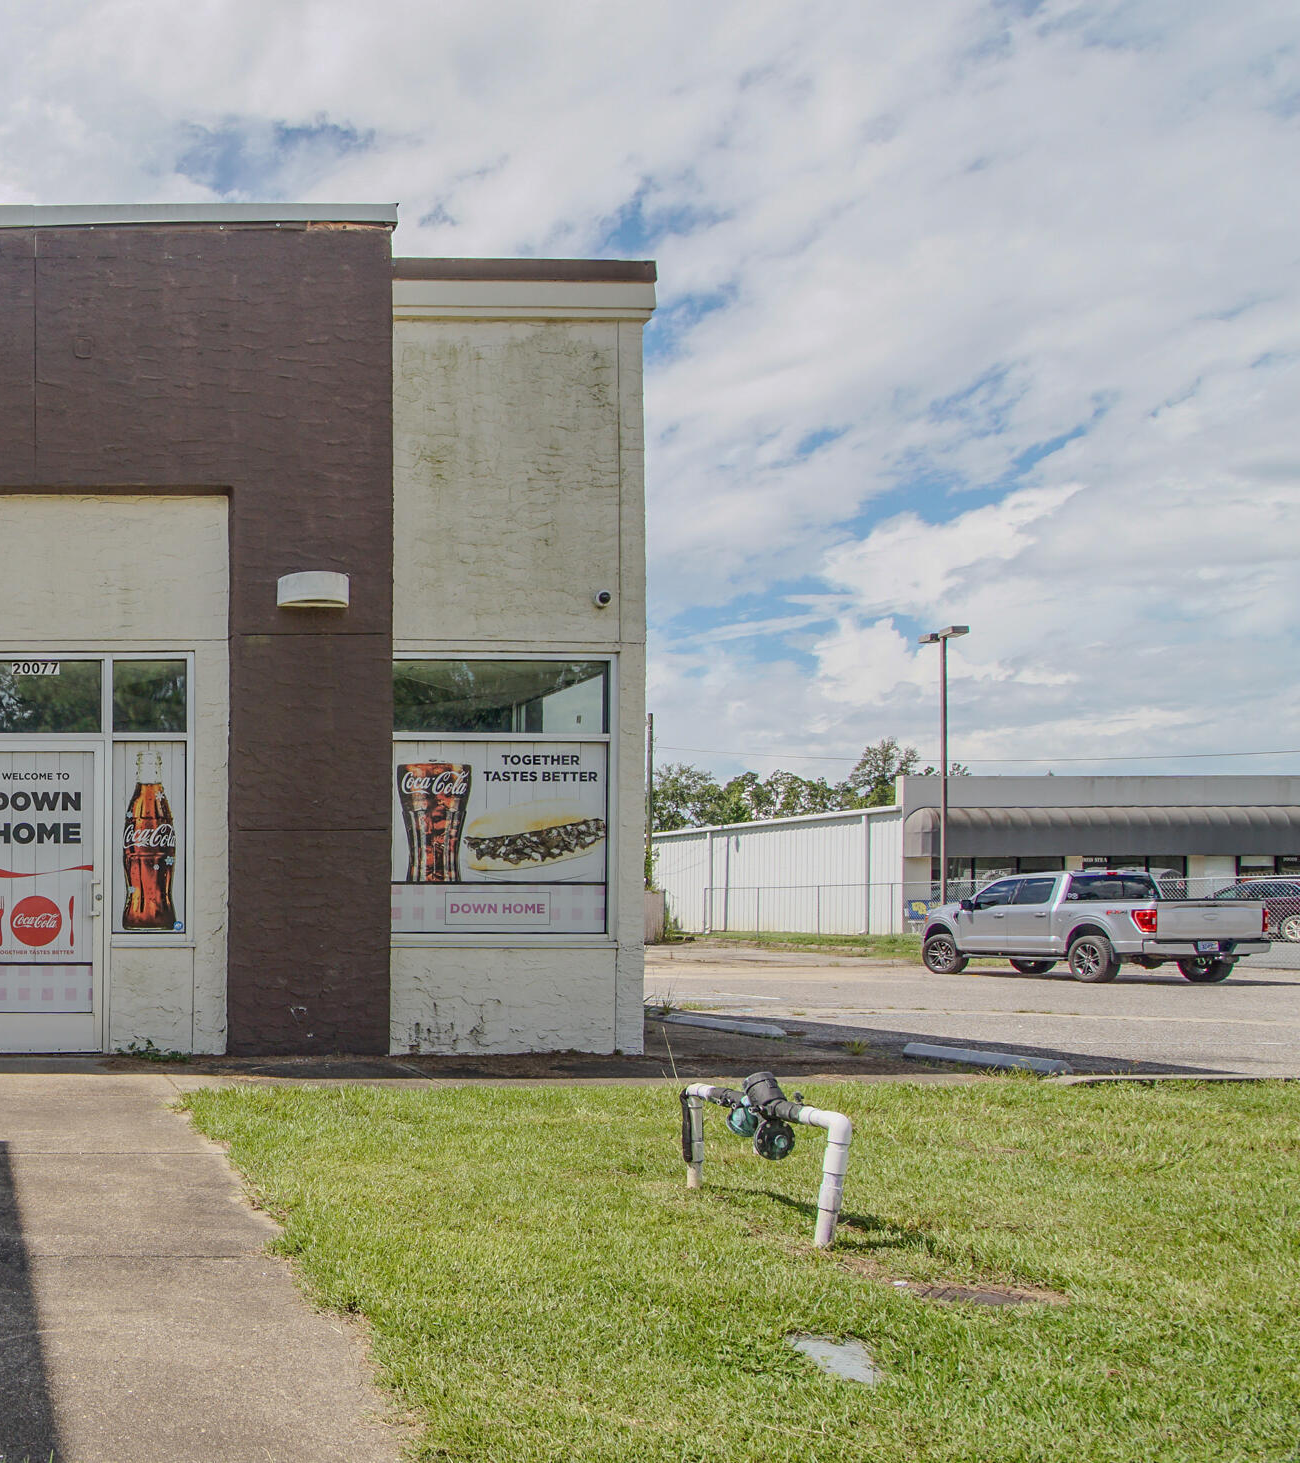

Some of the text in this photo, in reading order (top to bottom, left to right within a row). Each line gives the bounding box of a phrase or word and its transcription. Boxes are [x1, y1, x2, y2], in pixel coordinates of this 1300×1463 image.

[13, 662, 60, 675] 20077
[501, 755, 580, 766] TOGETHER
[2, 772, 70, 781] WELCOME TO
[401, 770, 470, 795] Coca-Cola
[484, 771, 598, 782] TASTES BETTER
[123, 824, 175, 848] Coca-Cola
[450, 903, 546, 915] DOWN HOME
[12, 913, 60, 928] Coca-Cola
